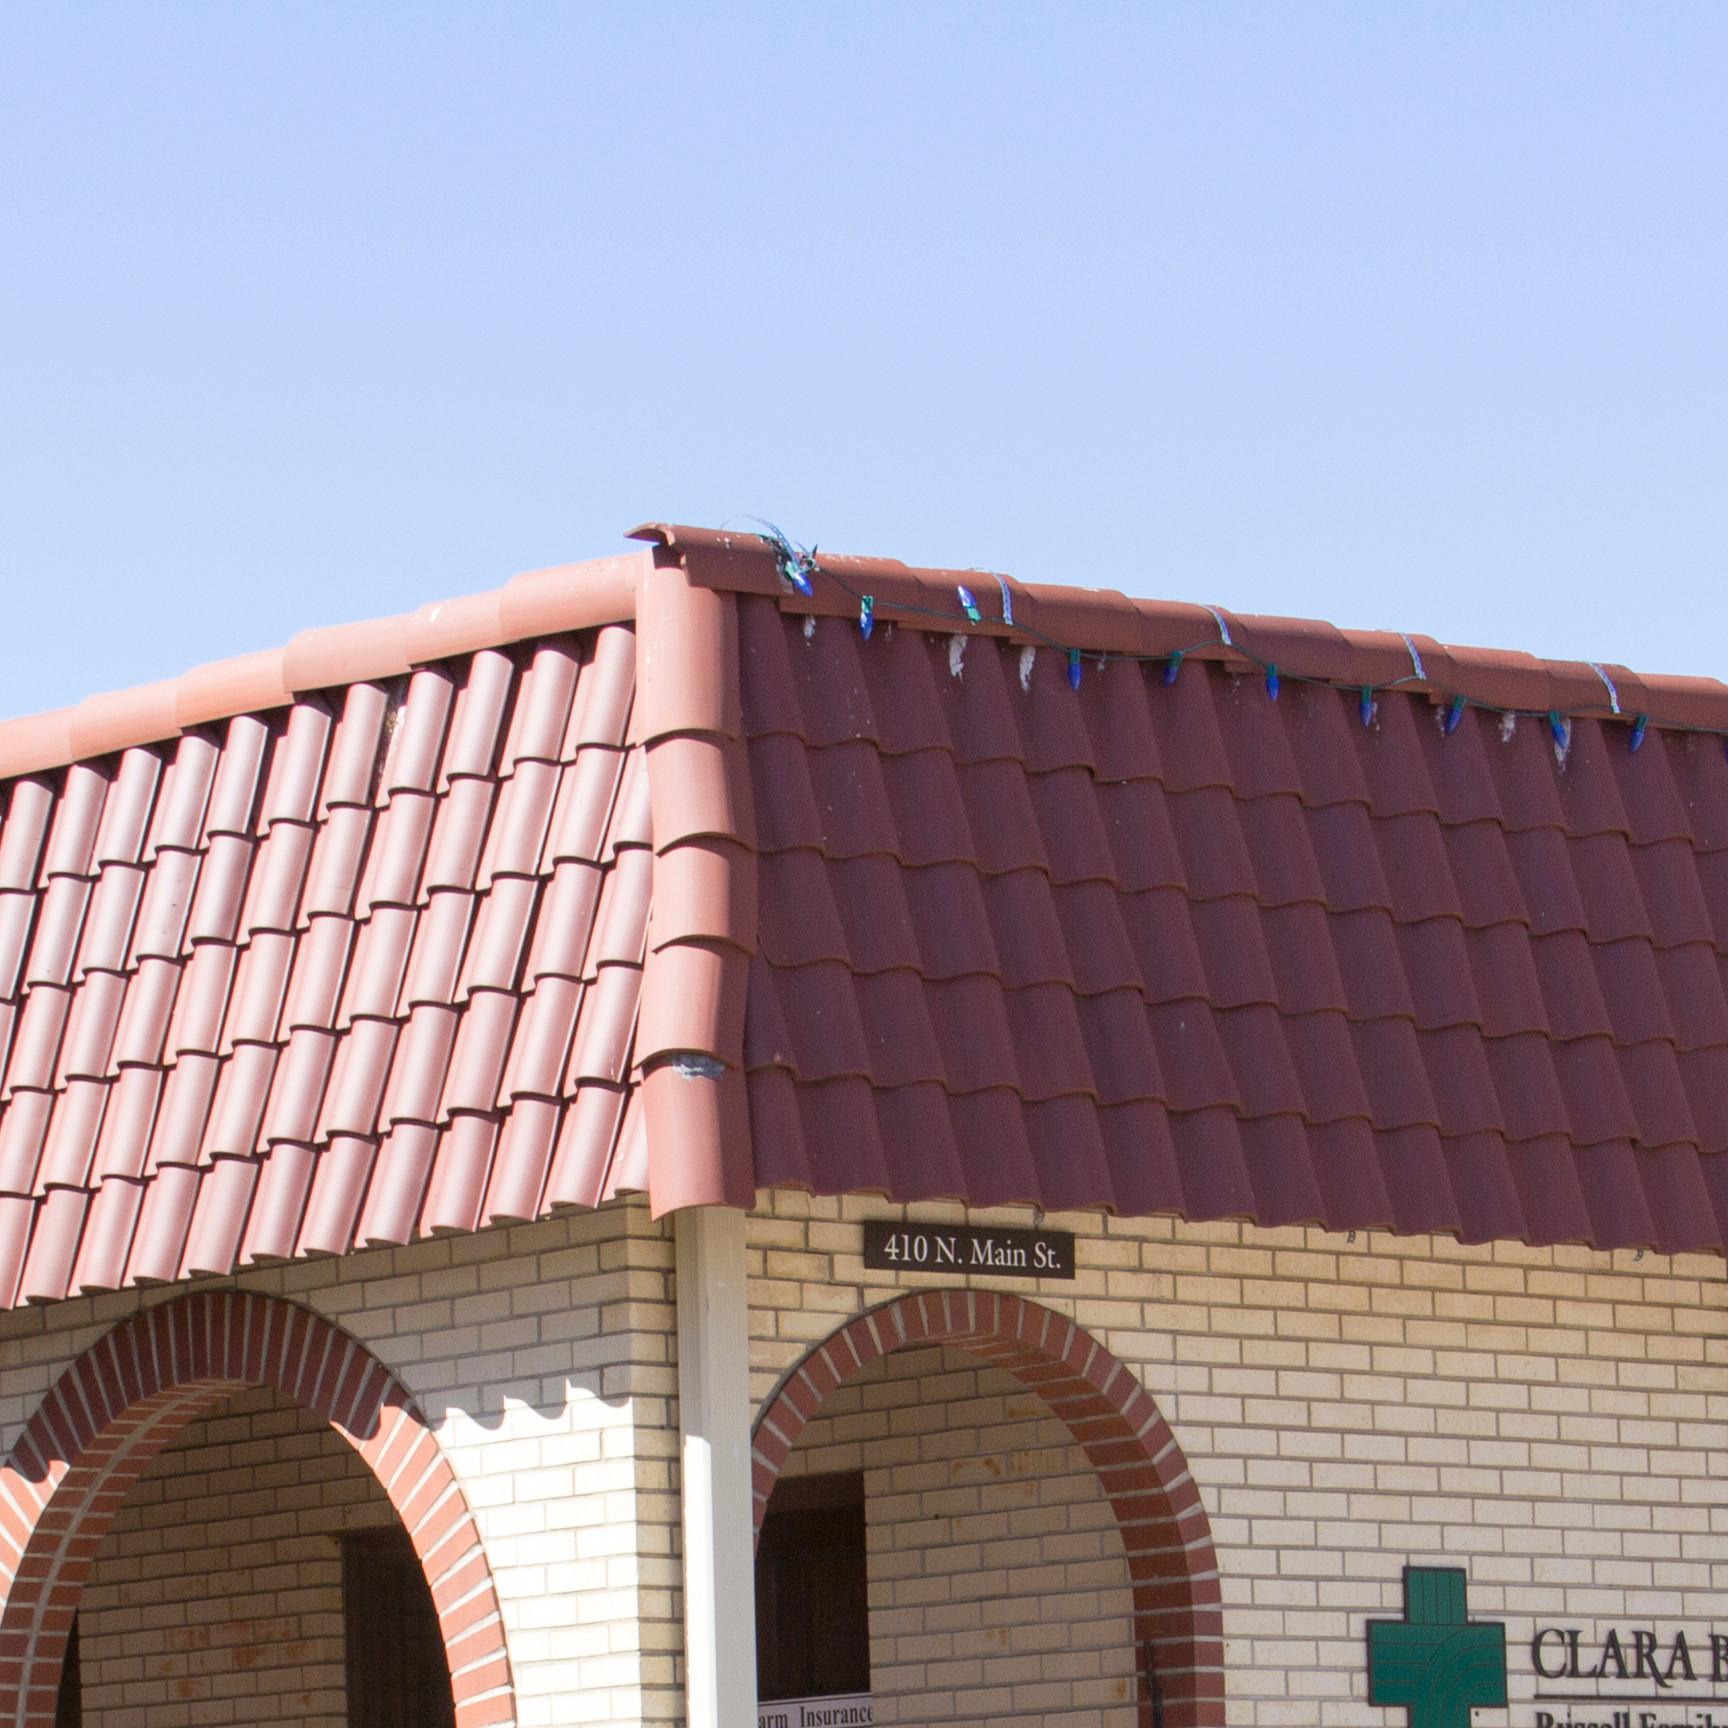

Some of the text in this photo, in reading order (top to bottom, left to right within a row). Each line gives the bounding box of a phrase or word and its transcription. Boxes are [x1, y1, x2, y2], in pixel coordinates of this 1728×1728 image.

[883, 1233, 1062, 1270] 410 N. Main St.
[1531, 1627, 1698, 1689] CLARA
